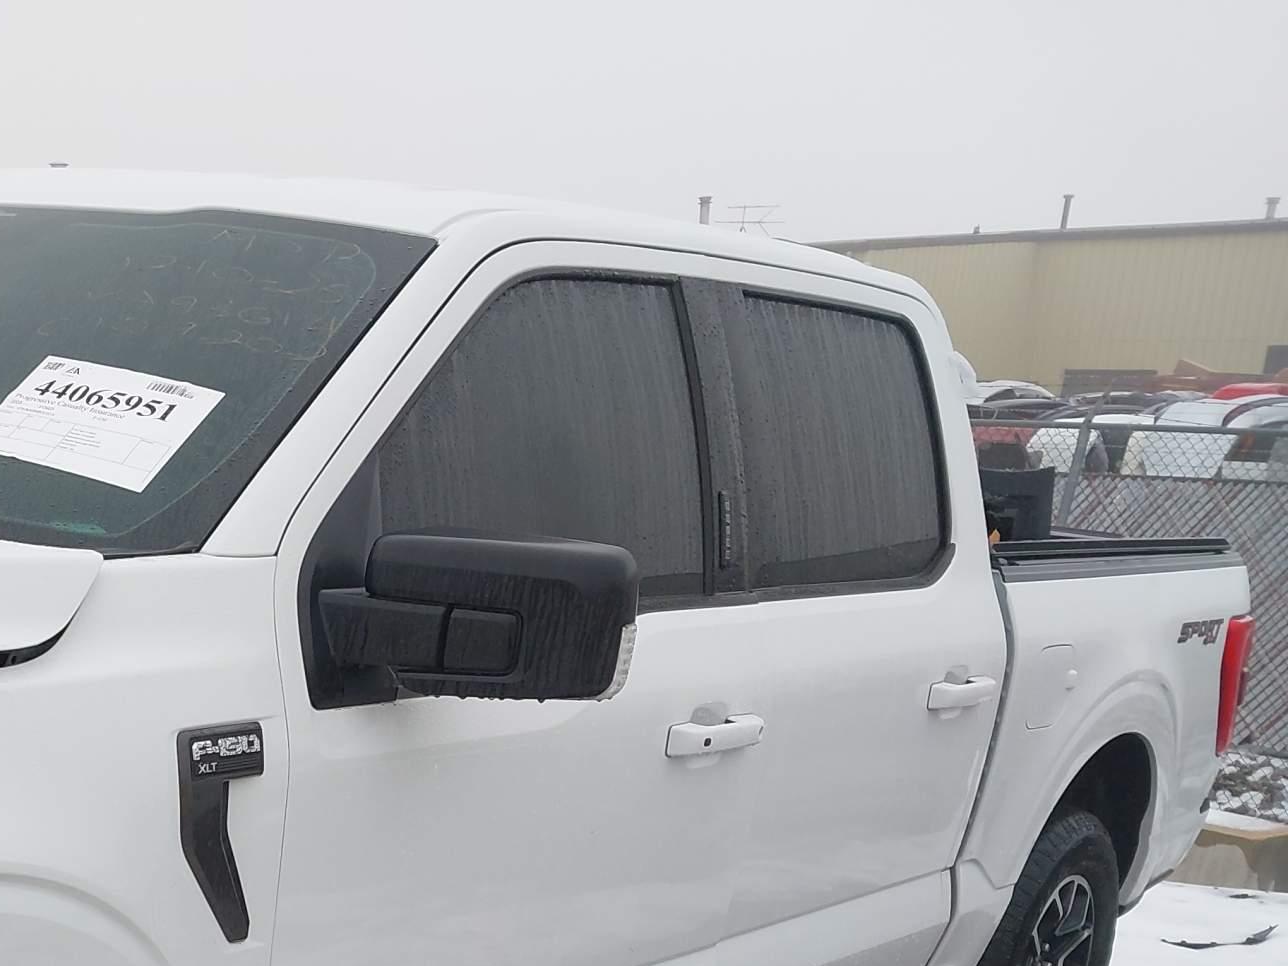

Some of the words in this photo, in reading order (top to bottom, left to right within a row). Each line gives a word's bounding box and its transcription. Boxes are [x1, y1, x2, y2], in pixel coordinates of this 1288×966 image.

[34, 380, 177, 422] 44065951
[57, 400, 88, 412] Casualty
[89, 406, 127, 420] Insurance
[1177, 618, 1225, 645] SPORT
[192, 734, 261, 761] F-150
[197, 762, 218, 775] XLT
